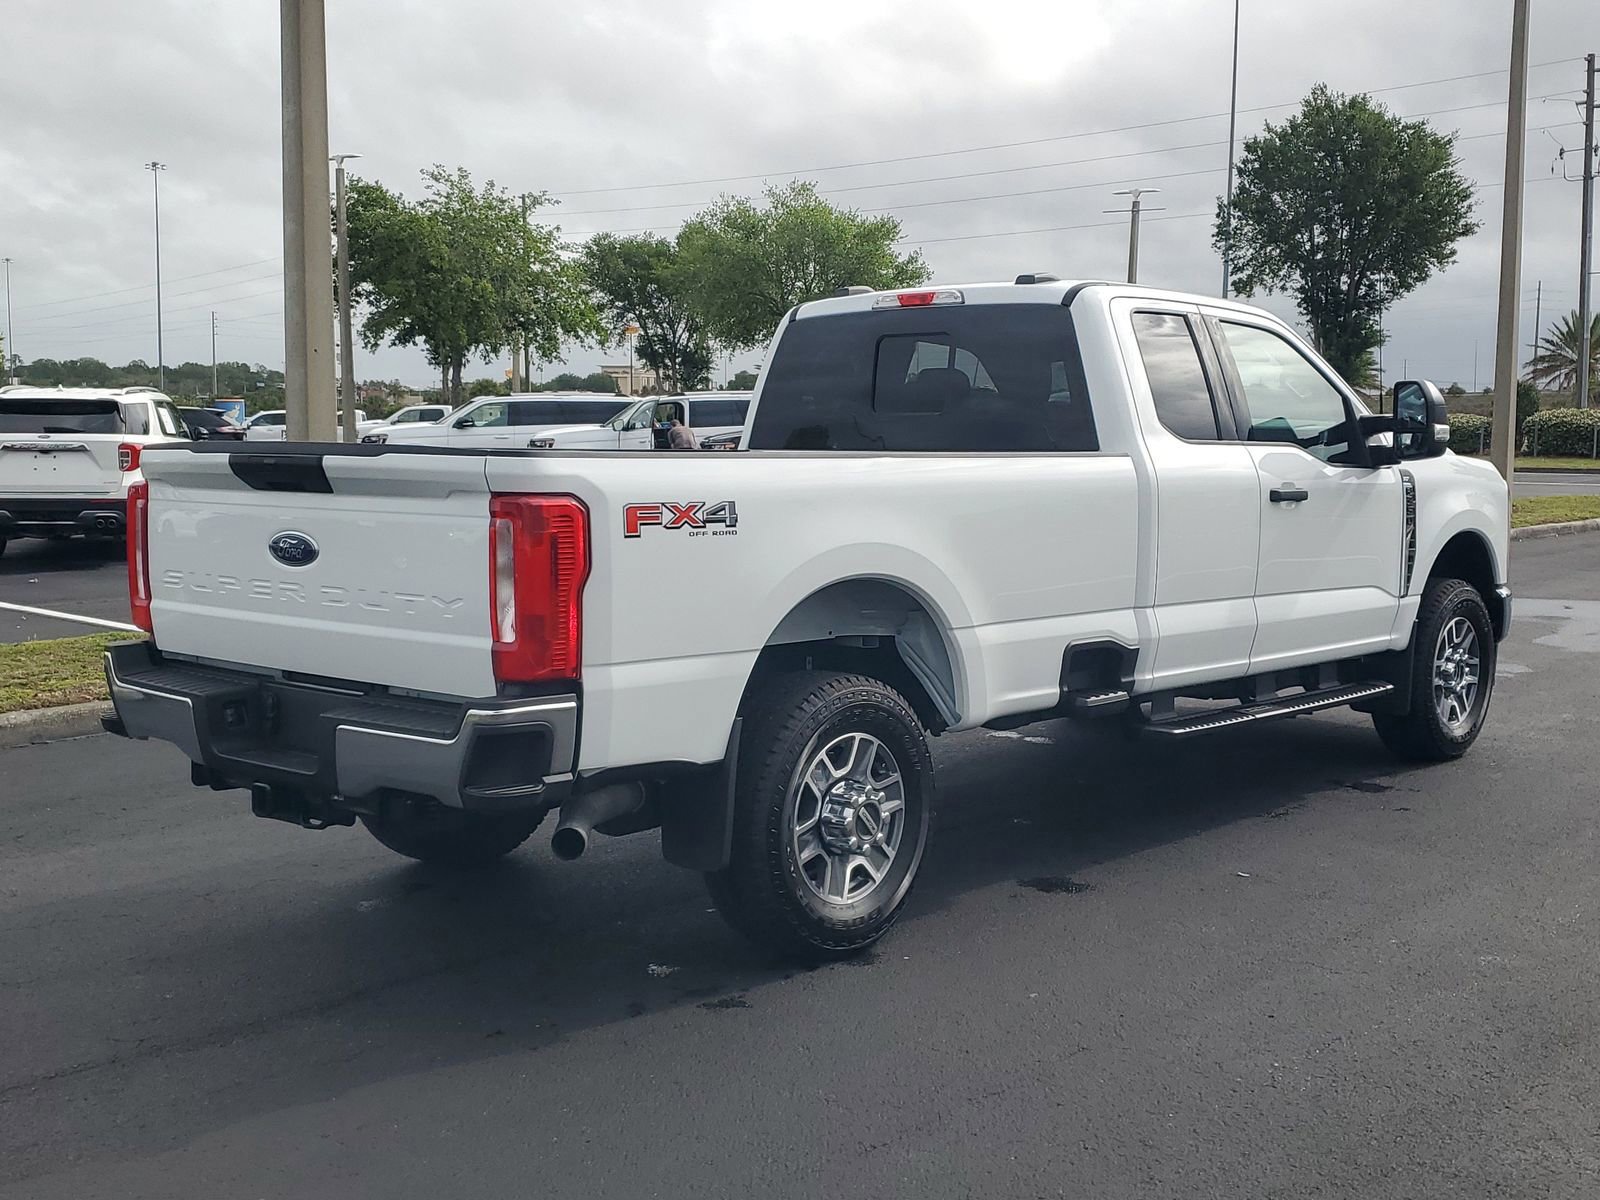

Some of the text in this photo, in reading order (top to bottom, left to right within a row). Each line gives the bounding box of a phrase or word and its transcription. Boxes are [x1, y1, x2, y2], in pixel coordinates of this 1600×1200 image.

[623, 501, 738, 538] FX4
[163, 569, 464, 619] SUPER DUTY
